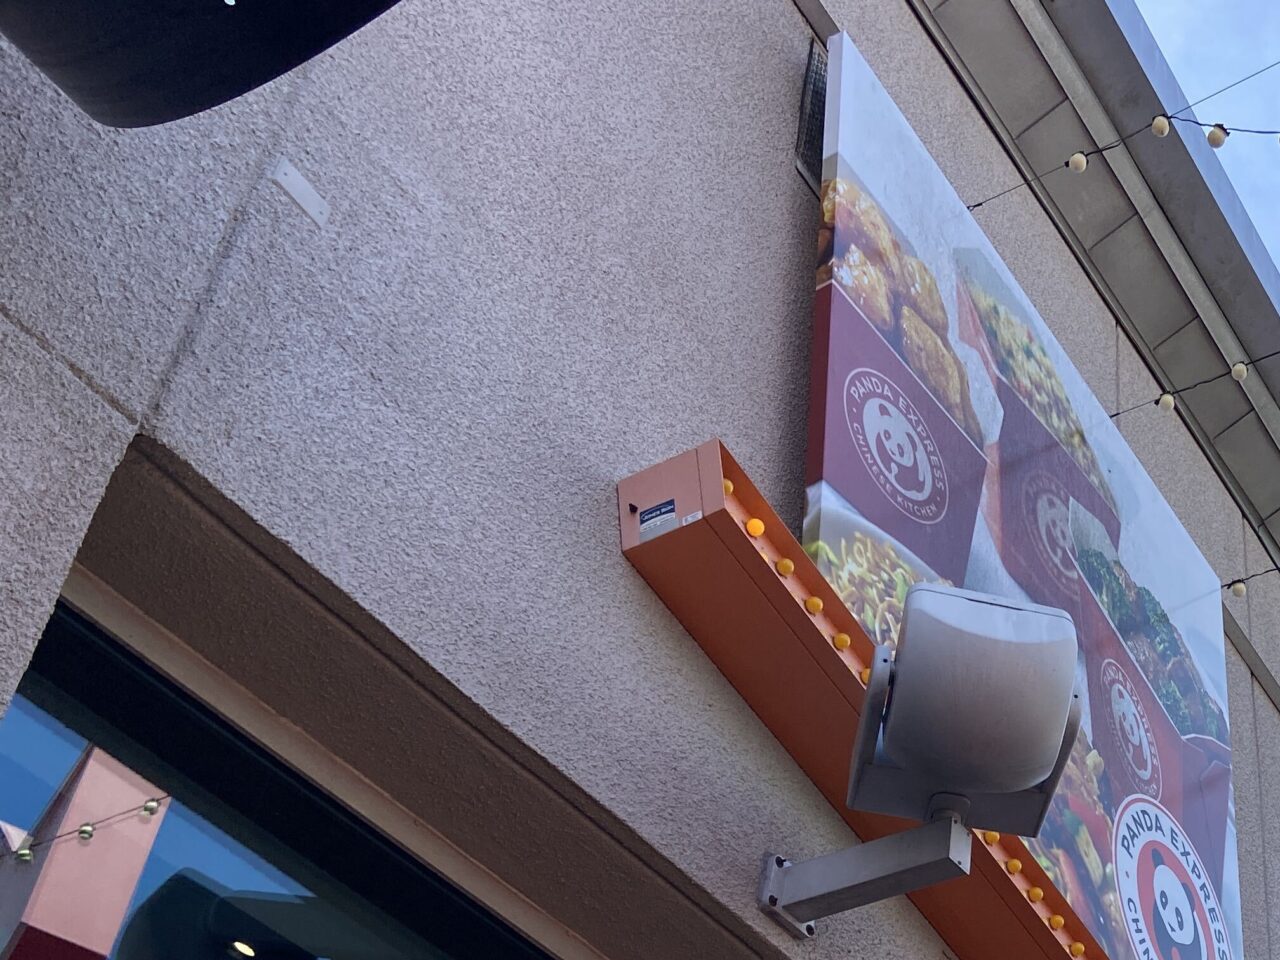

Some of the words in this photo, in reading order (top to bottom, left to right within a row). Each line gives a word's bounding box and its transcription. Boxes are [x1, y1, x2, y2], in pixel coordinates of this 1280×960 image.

[850, 375, 894, 403] PANDA
[897, 399, 945, 491] EXPRESS
[852, 422, 893, 494] CHINESE
[896, 497, 938, 518] KITCHEN
[1120, 808, 1167, 859] PANDA
